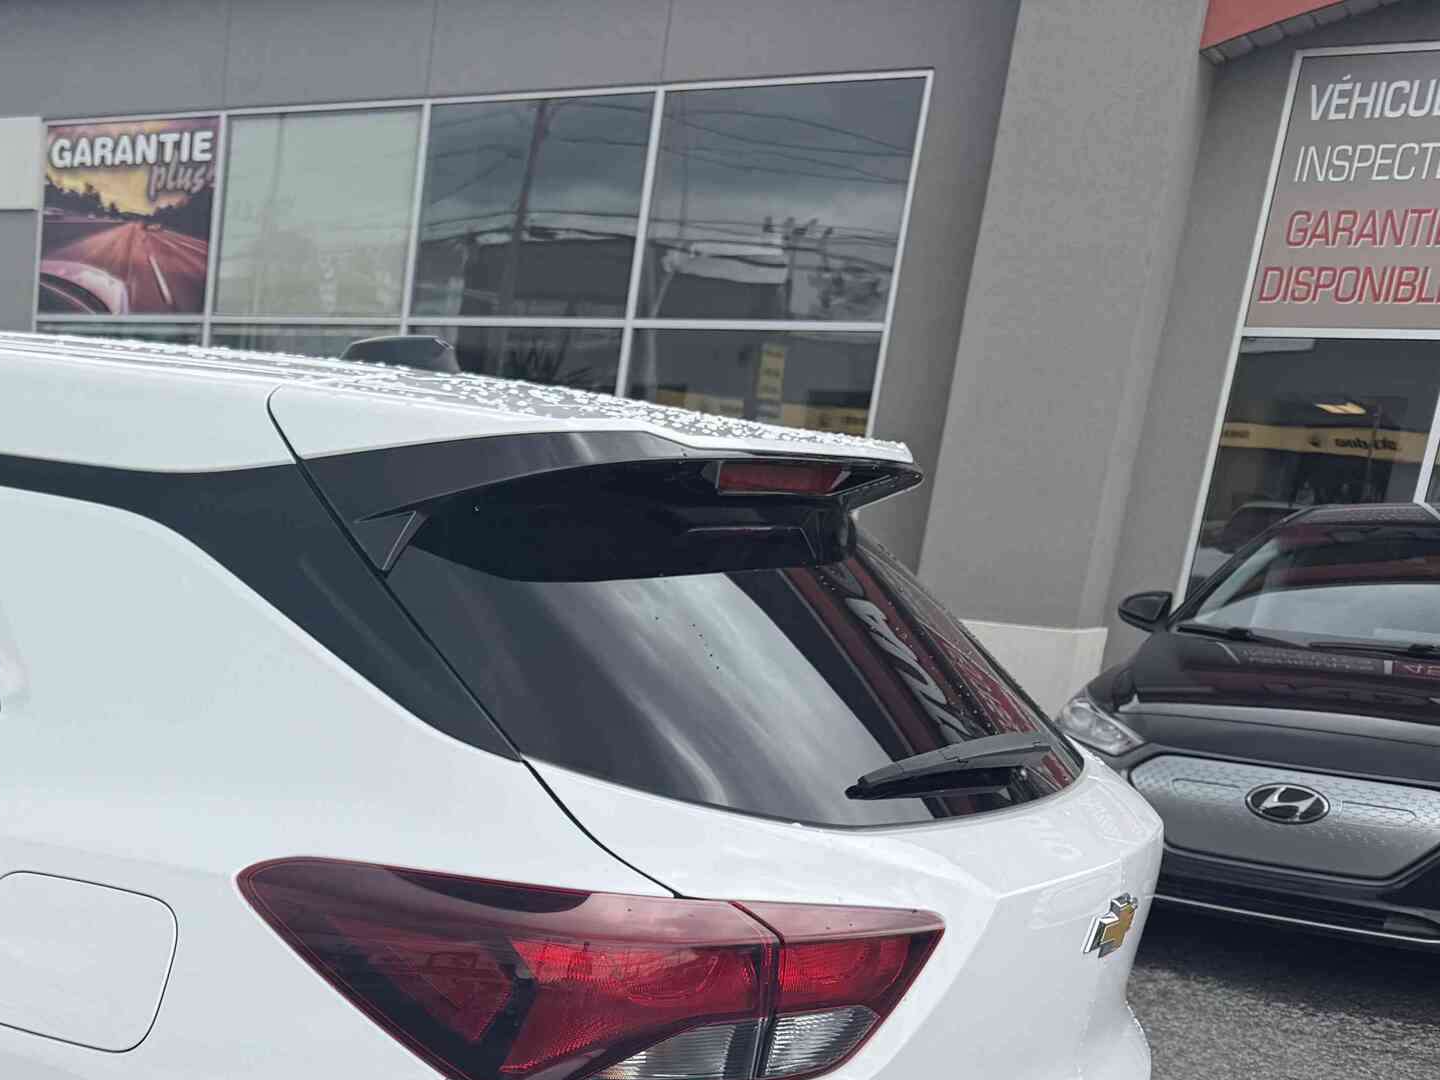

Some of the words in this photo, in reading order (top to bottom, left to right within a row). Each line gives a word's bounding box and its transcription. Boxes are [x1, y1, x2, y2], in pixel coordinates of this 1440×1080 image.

[50, 131, 213, 168] GARANTIE
[1293, 142, 1440, 183] INSPECT
[1286, 207, 1440, 248] GARANTI
[1258, 266, 1440, 305] DISPONIBL
